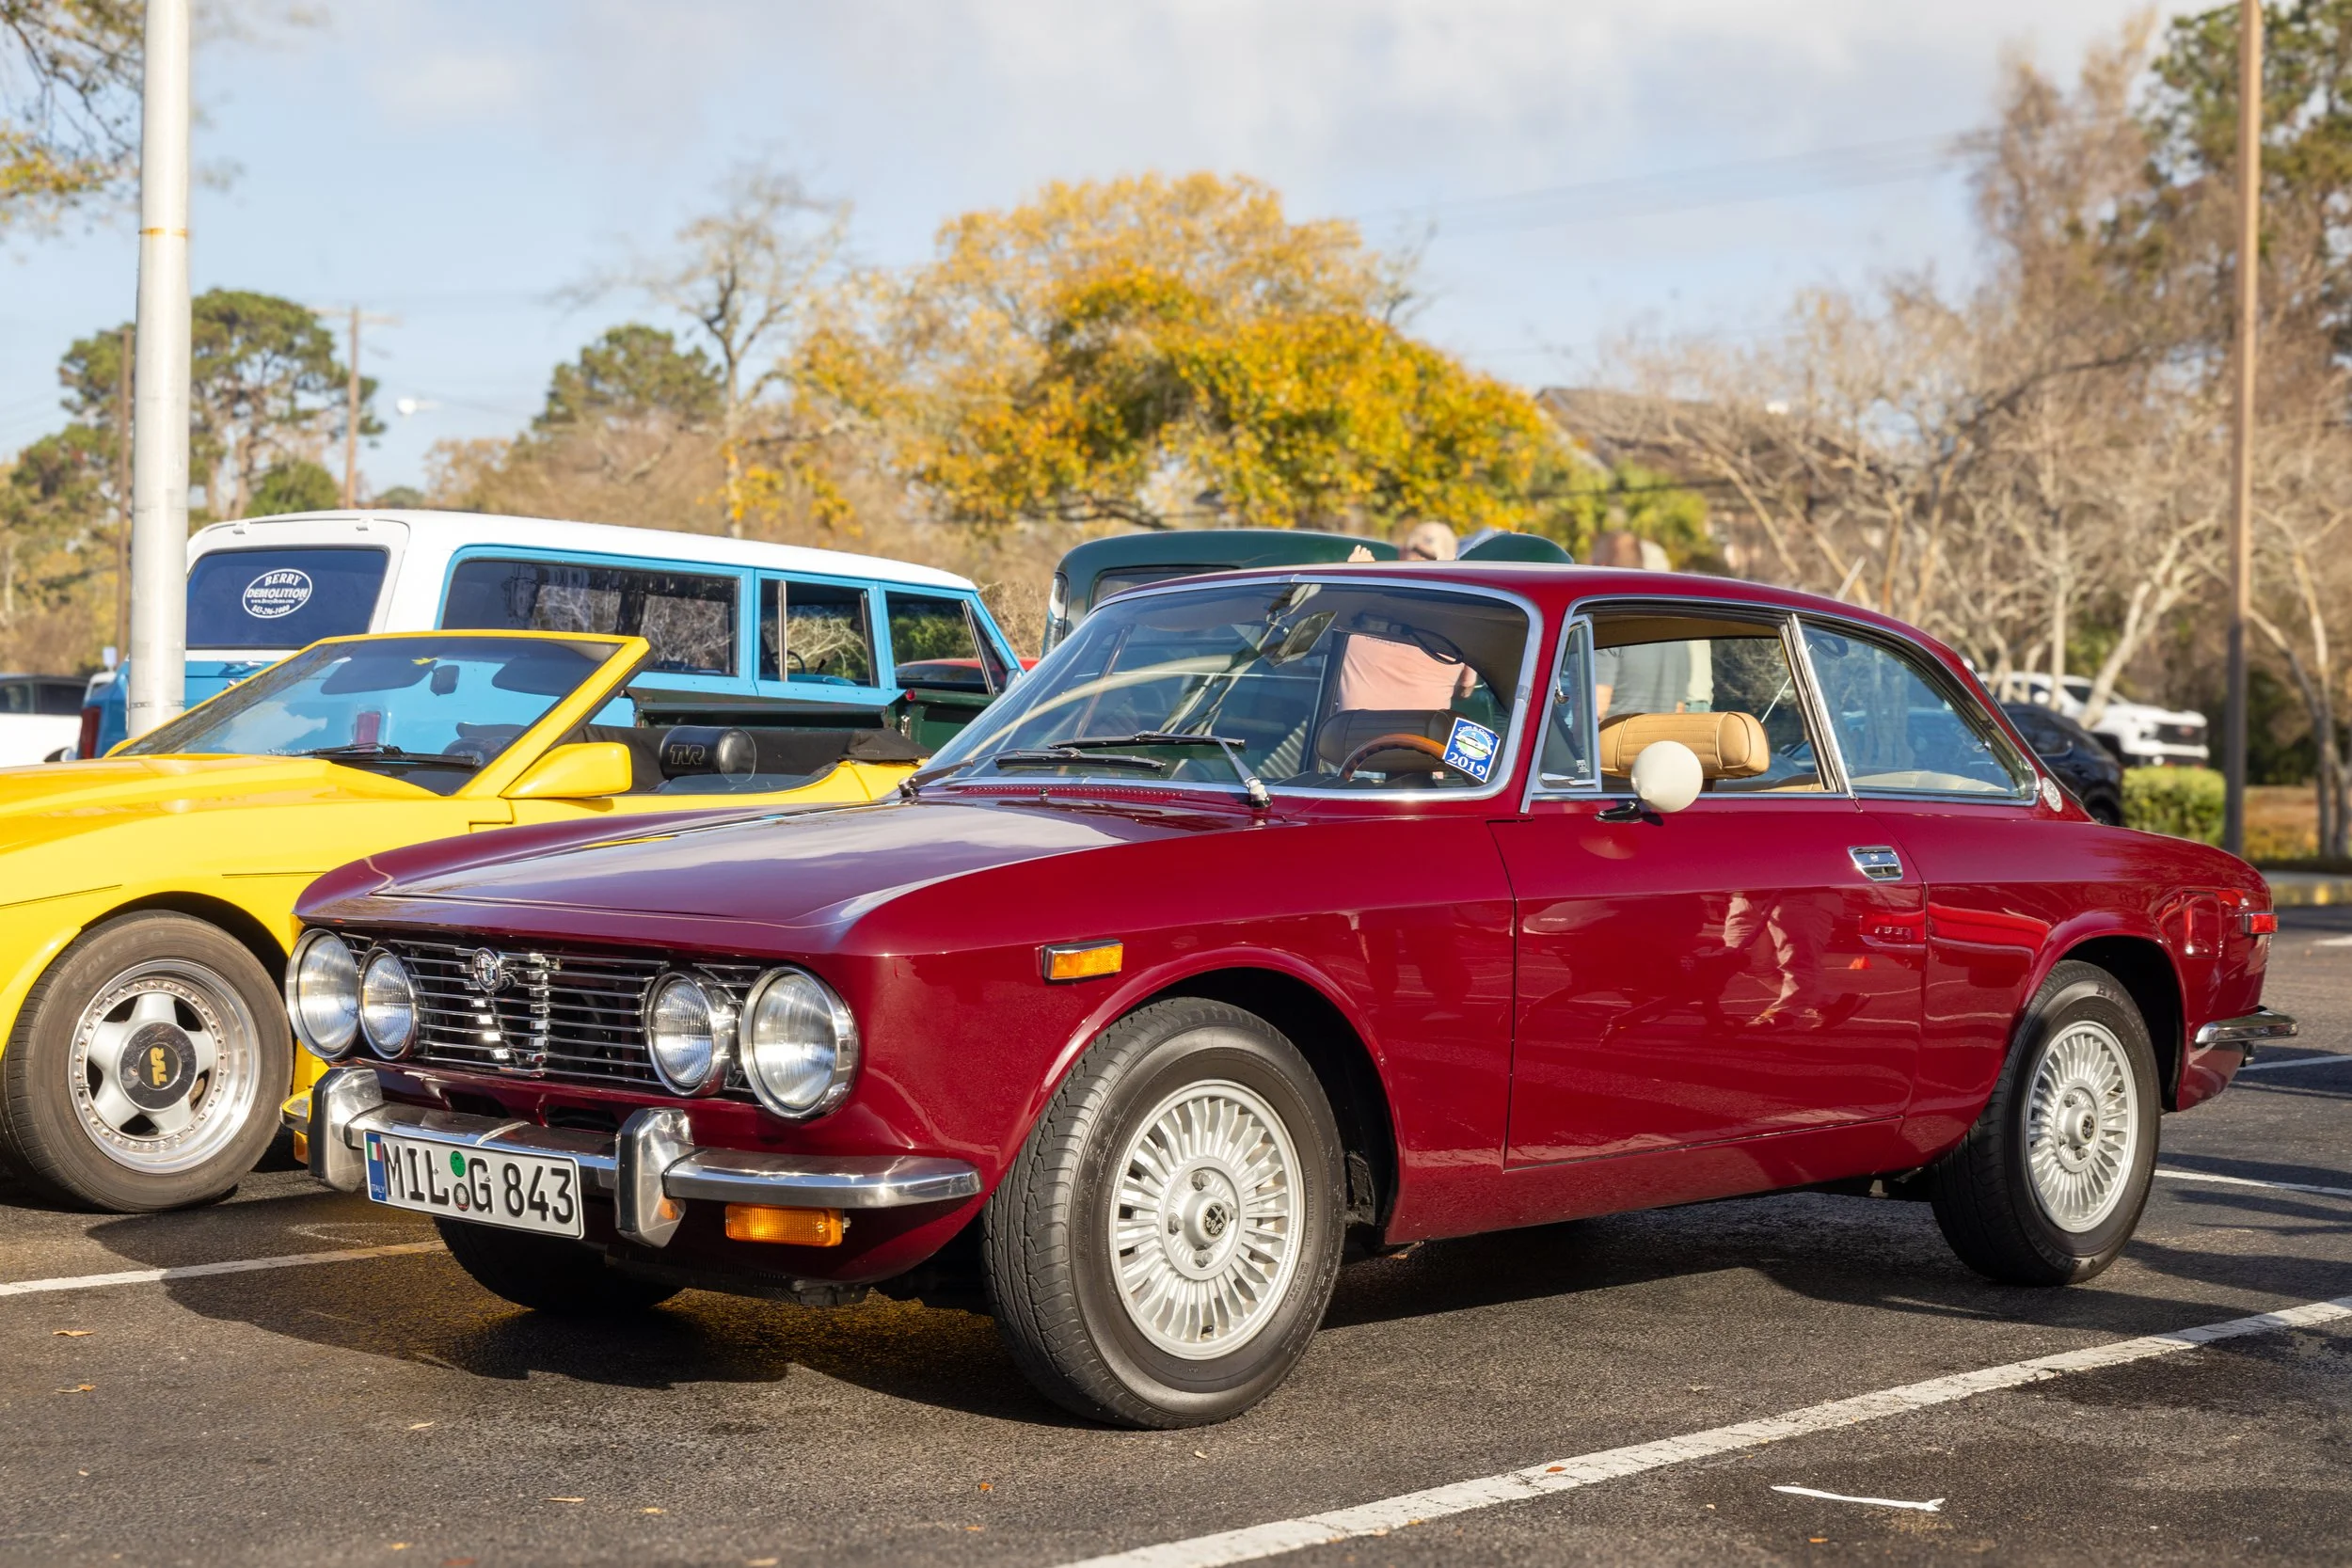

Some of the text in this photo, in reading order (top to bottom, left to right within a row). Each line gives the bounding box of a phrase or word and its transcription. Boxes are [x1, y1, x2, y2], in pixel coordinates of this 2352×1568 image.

[264, 573, 302, 586] BERRY
[246, 588, 309, 598] DEMOLITION
[669, 744, 706, 765] TVR
[1447, 752, 1486, 776] 2019
[151, 1047, 167, 1085] TVR
[371, 1183, 386, 1194] ITALY
[383, 1142, 575, 1225] MIL G 843
